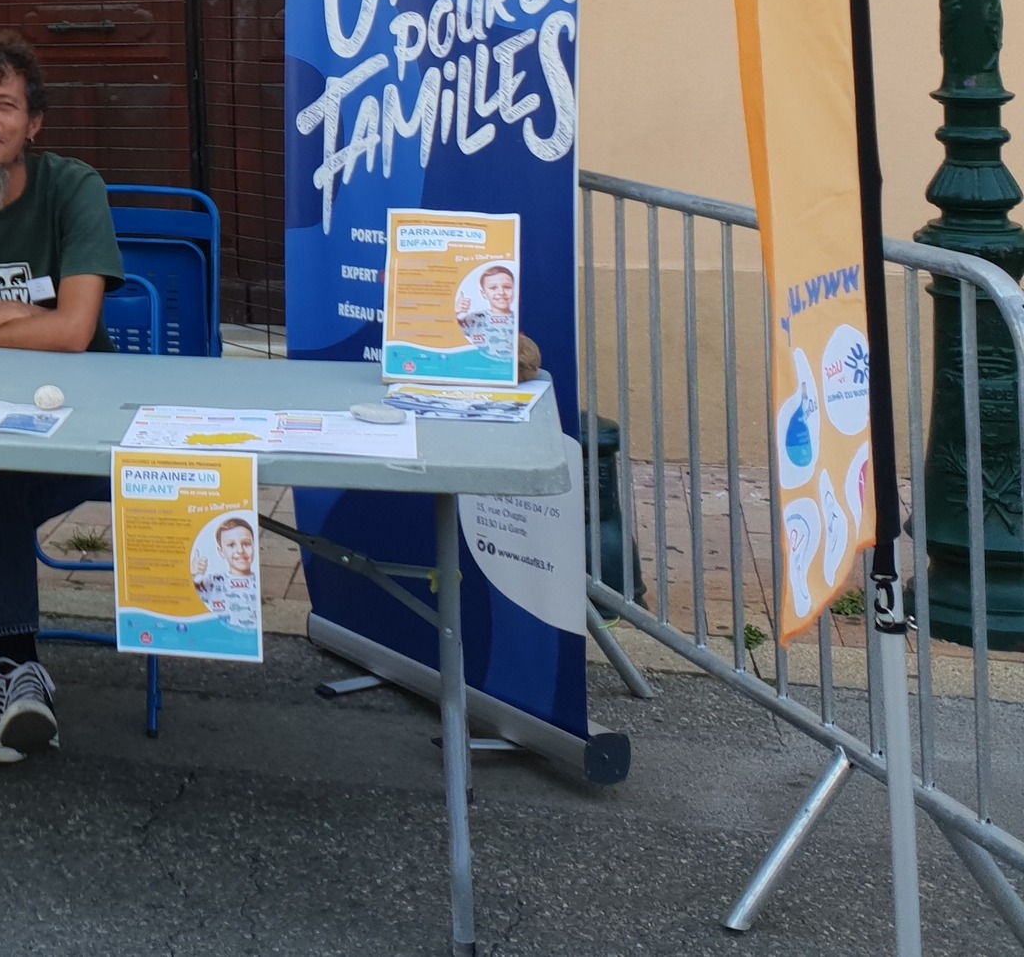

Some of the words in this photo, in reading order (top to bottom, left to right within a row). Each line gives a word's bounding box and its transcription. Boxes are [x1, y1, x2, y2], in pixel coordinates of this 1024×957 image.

[400, 228, 463, 238] PARRAINEZ
[466, 230, 483, 239] UN
[400, 239, 444, 247] ENFANT
[341, 265, 378, 282] EXPERT
[338, 300, 374, 322] RÉSEAU
[125, 470, 195, 482] PARRAINEZ
[198, 474, 215, 483] UN
[126, 483, 174, 494] ENFANT
[488, 507, 501, 515] rue
[499, 522, 507, 531] La
[497, 549, 555, 573] www.udaf83.fr
